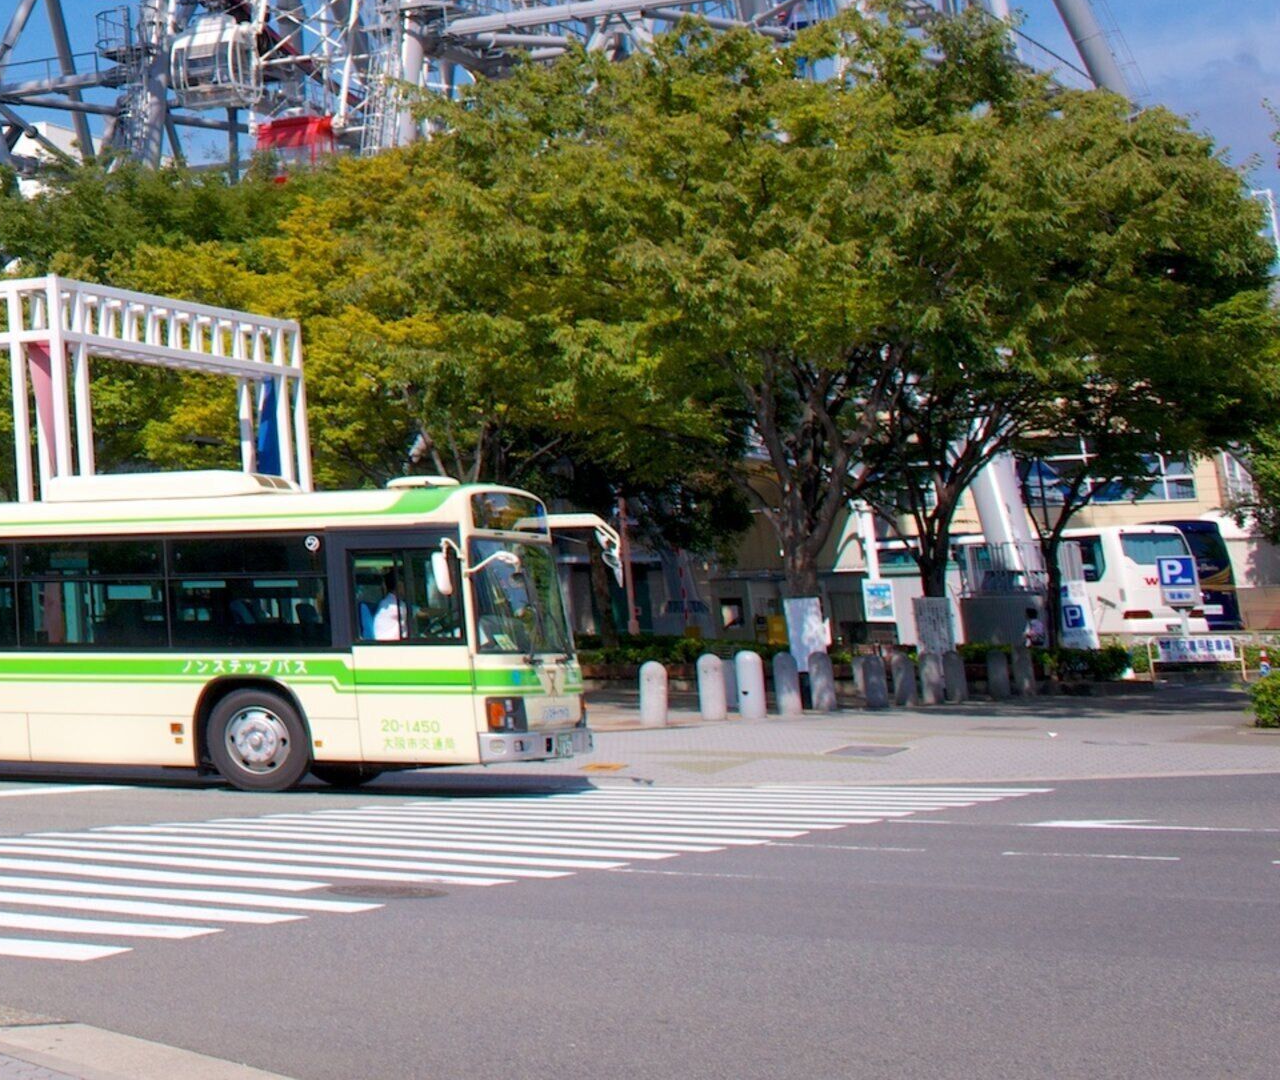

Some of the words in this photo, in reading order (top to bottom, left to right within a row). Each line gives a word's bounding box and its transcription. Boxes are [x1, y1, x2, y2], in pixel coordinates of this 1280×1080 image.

[1160, 560, 1183, 584] P
[1065, 607, 1080, 626] P
[182, 659, 308, 674] ノンステップバス
[380, 718, 441, 734] 20-1450
